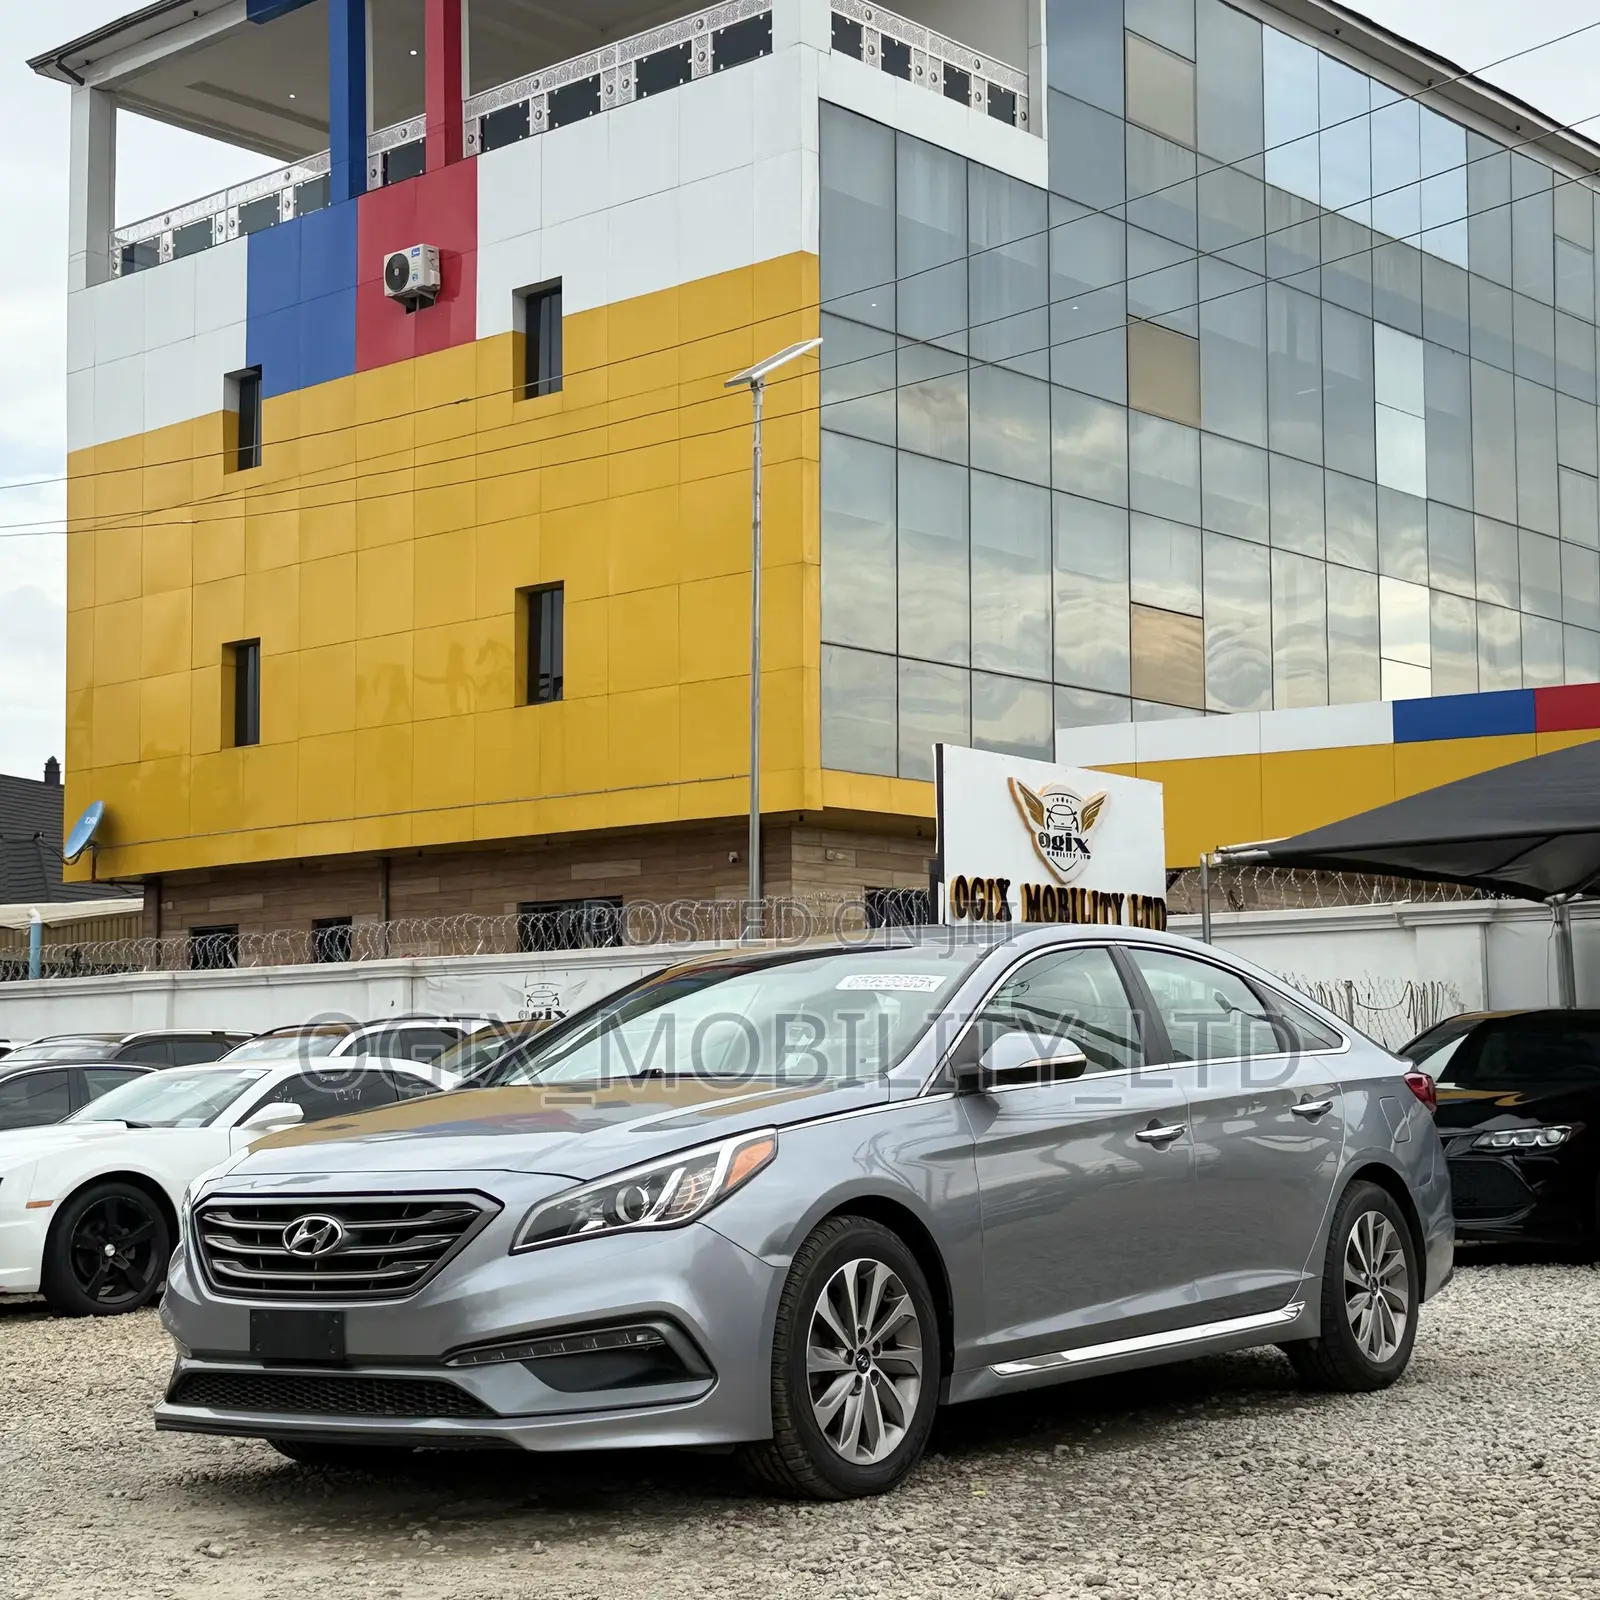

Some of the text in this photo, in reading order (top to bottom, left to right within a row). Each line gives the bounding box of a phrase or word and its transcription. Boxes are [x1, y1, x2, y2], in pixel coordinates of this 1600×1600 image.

[950, 875, 1167, 932] OGIX MOBILITY LTD
